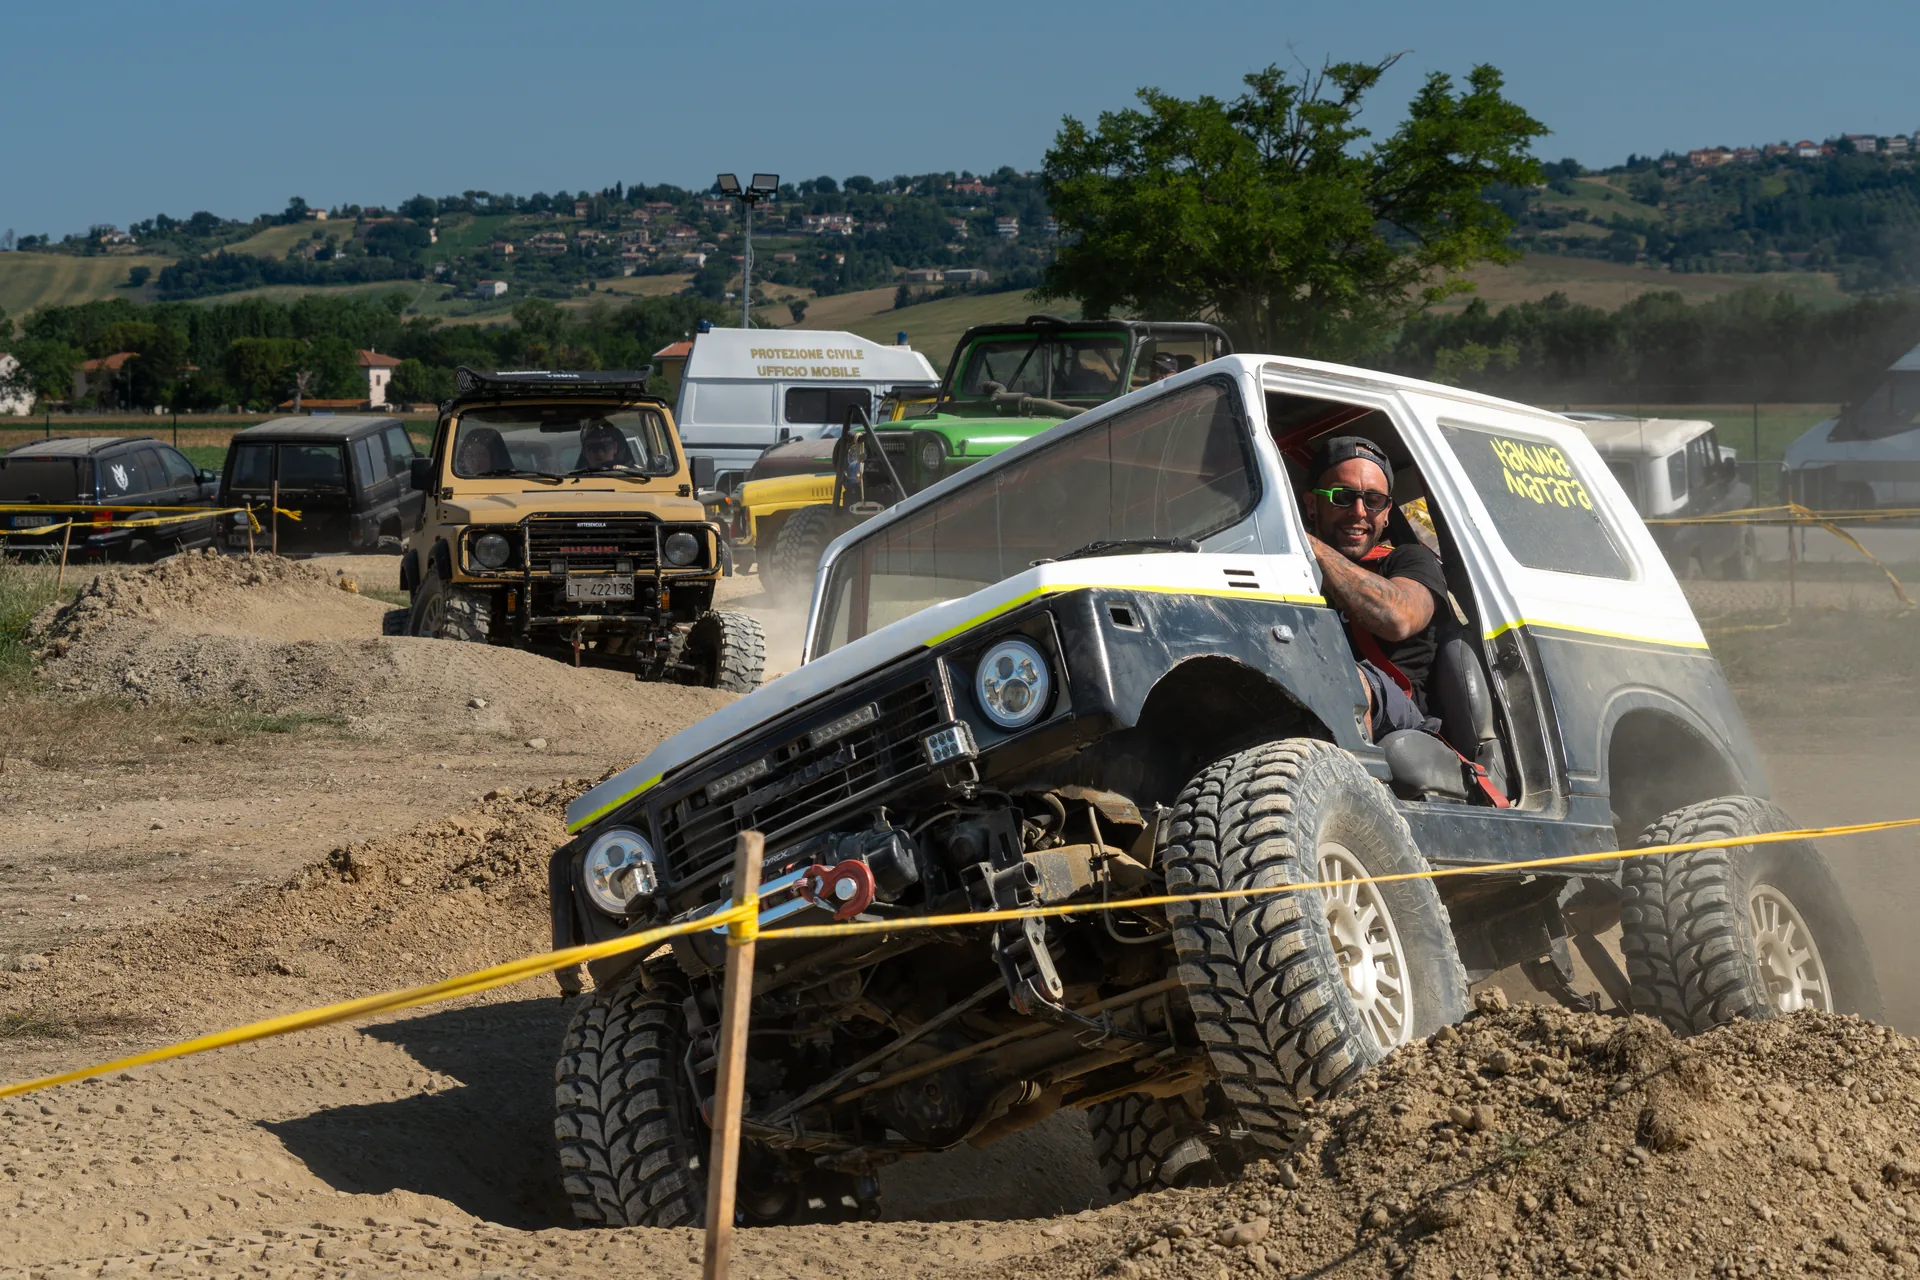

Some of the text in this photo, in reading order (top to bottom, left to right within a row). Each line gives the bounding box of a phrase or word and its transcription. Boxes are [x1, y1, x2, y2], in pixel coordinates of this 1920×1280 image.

[750, 348, 865, 360] PROTEZIONE CIVILE
[757, 365, 861, 378] UFFICIO MOBILE
